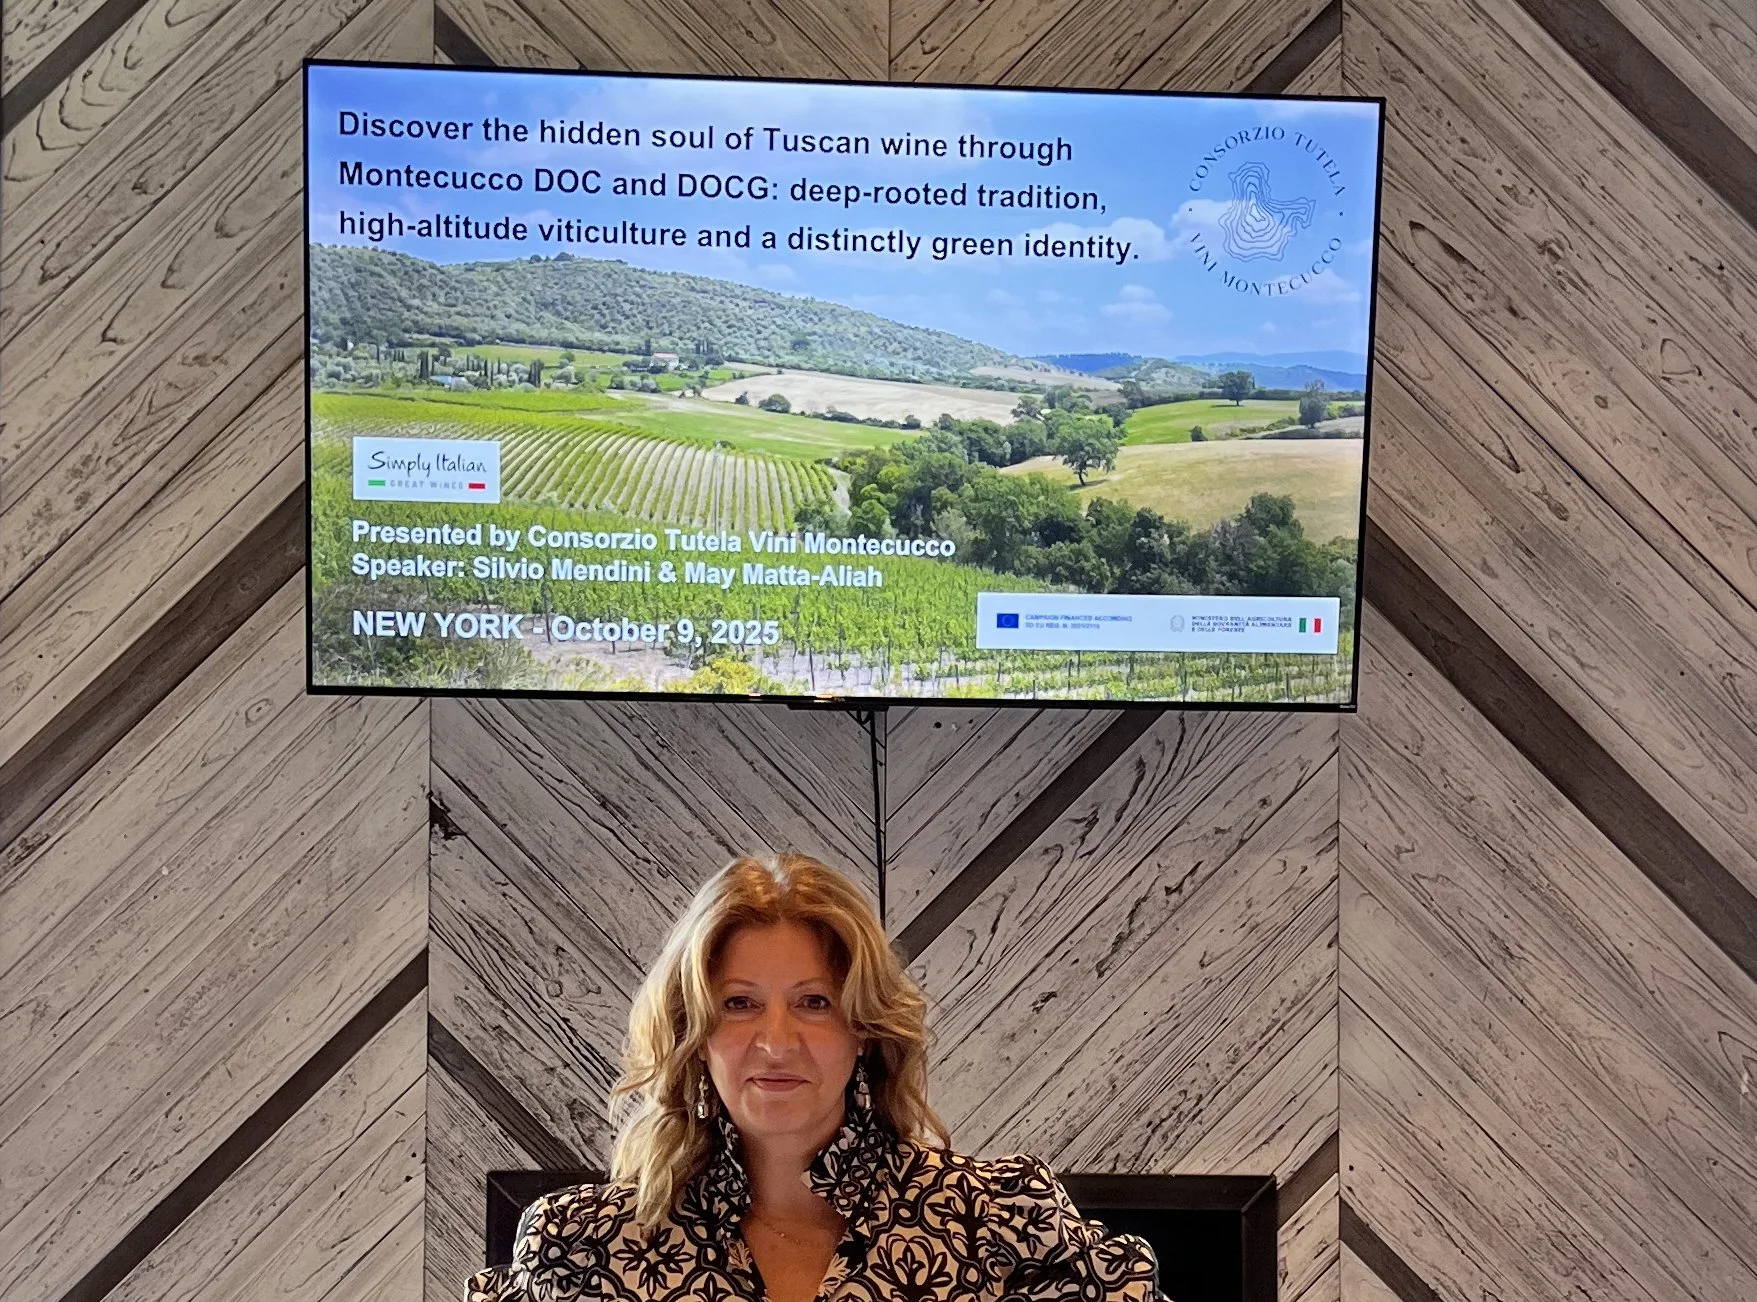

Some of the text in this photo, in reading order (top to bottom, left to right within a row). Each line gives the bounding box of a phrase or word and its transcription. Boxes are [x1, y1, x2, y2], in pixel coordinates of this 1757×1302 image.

[339, 110, 1073, 168] Discover the hidden soul of Tuscan wine through
[1189, 126, 1285, 192] CONSORZIO
[1294, 132, 1346, 196] TUTELA
[339, 161, 1107, 215] Montecucco DOC and DOCG: deep-rooted tradition,
[339, 211, 1139, 266] high-altitude viticulture and a distinctly green identity.
[1190, 233, 1342, 296] VINI MONTECUCCO
[368, 451, 487, 478] Simply Italian
[353, 520, 956, 557] Presented by Consorzio Tutela Vini Montecucco
[352, 553, 883, 589] Speaker: Silvio Mendini & May Matta-Aliah
[353, 610, 427, 638] NEW
[434, 612, 523, 640] YORK
[551, 616, 671, 643] October
[677, 619, 702, 648] 9,
[712, 621, 780, 646] 2025
